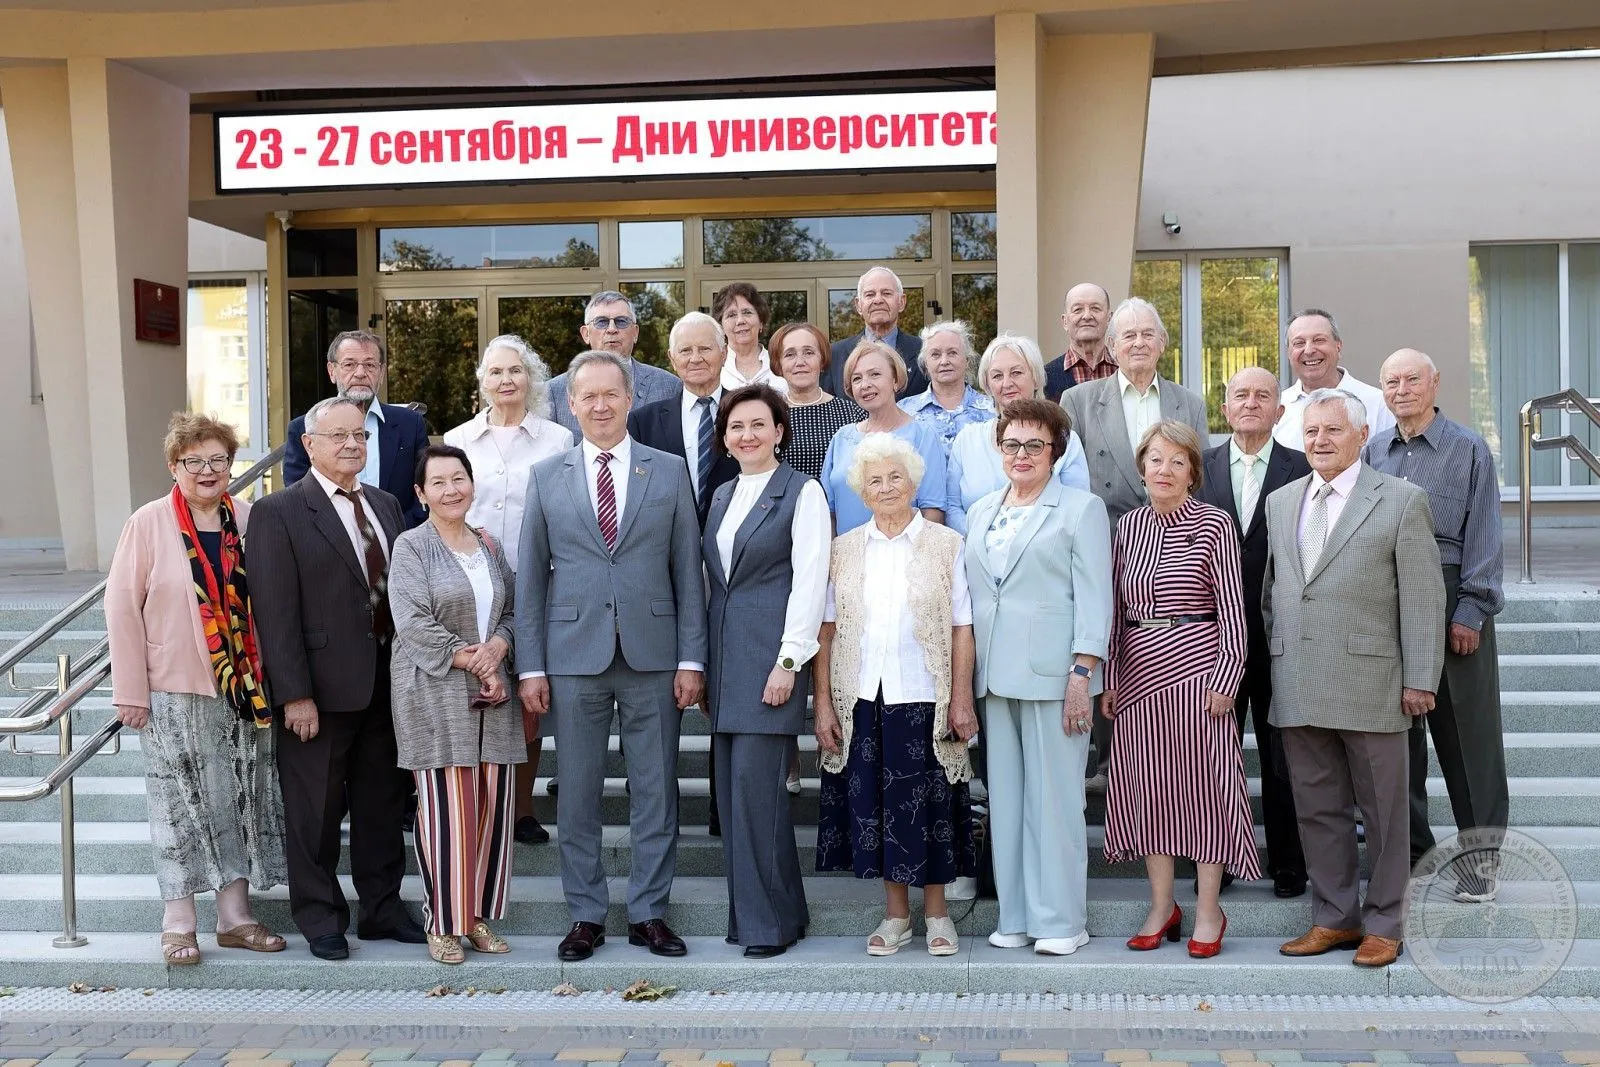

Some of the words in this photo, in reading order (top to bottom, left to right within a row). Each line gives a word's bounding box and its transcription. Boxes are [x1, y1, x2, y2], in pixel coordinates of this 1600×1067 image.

[236, 128, 283, 169] 23
[318, 126, 359, 166] 27
[370, 120, 567, 165] сентября
[612, 115, 697, 163] Дни
